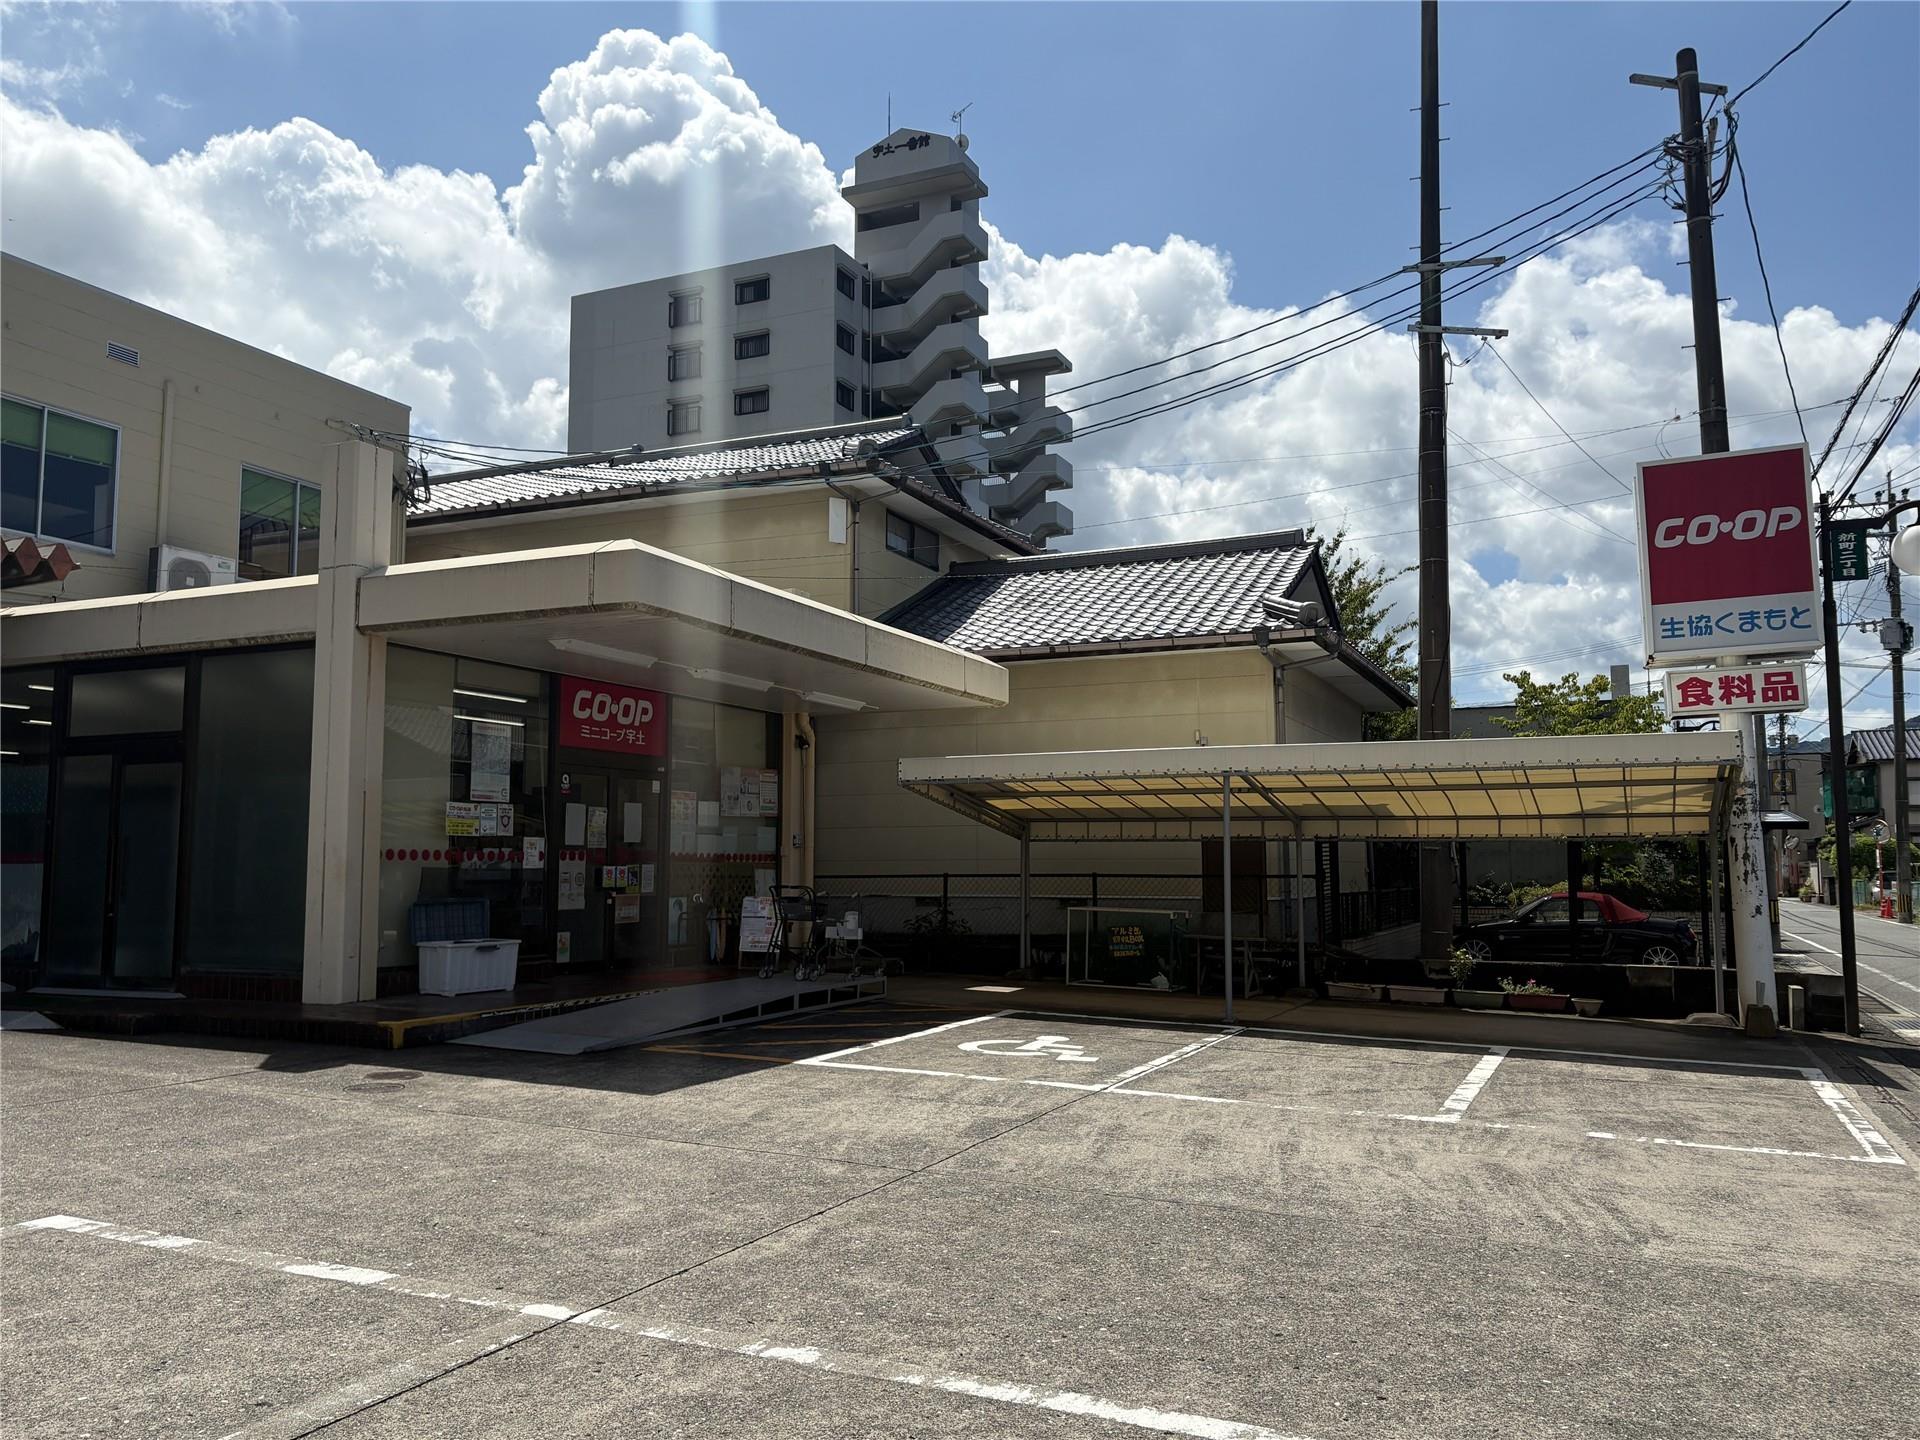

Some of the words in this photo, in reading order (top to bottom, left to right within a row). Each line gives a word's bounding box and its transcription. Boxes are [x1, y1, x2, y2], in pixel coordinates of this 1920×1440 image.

[1837, 532, 1858, 577] 新町二丁目
[1660, 606, 1812, 640] 生協くまもと
[1676, 671, 1801, 708] 食料品
[580, 725, 646, 745] ミニコープ宇土
